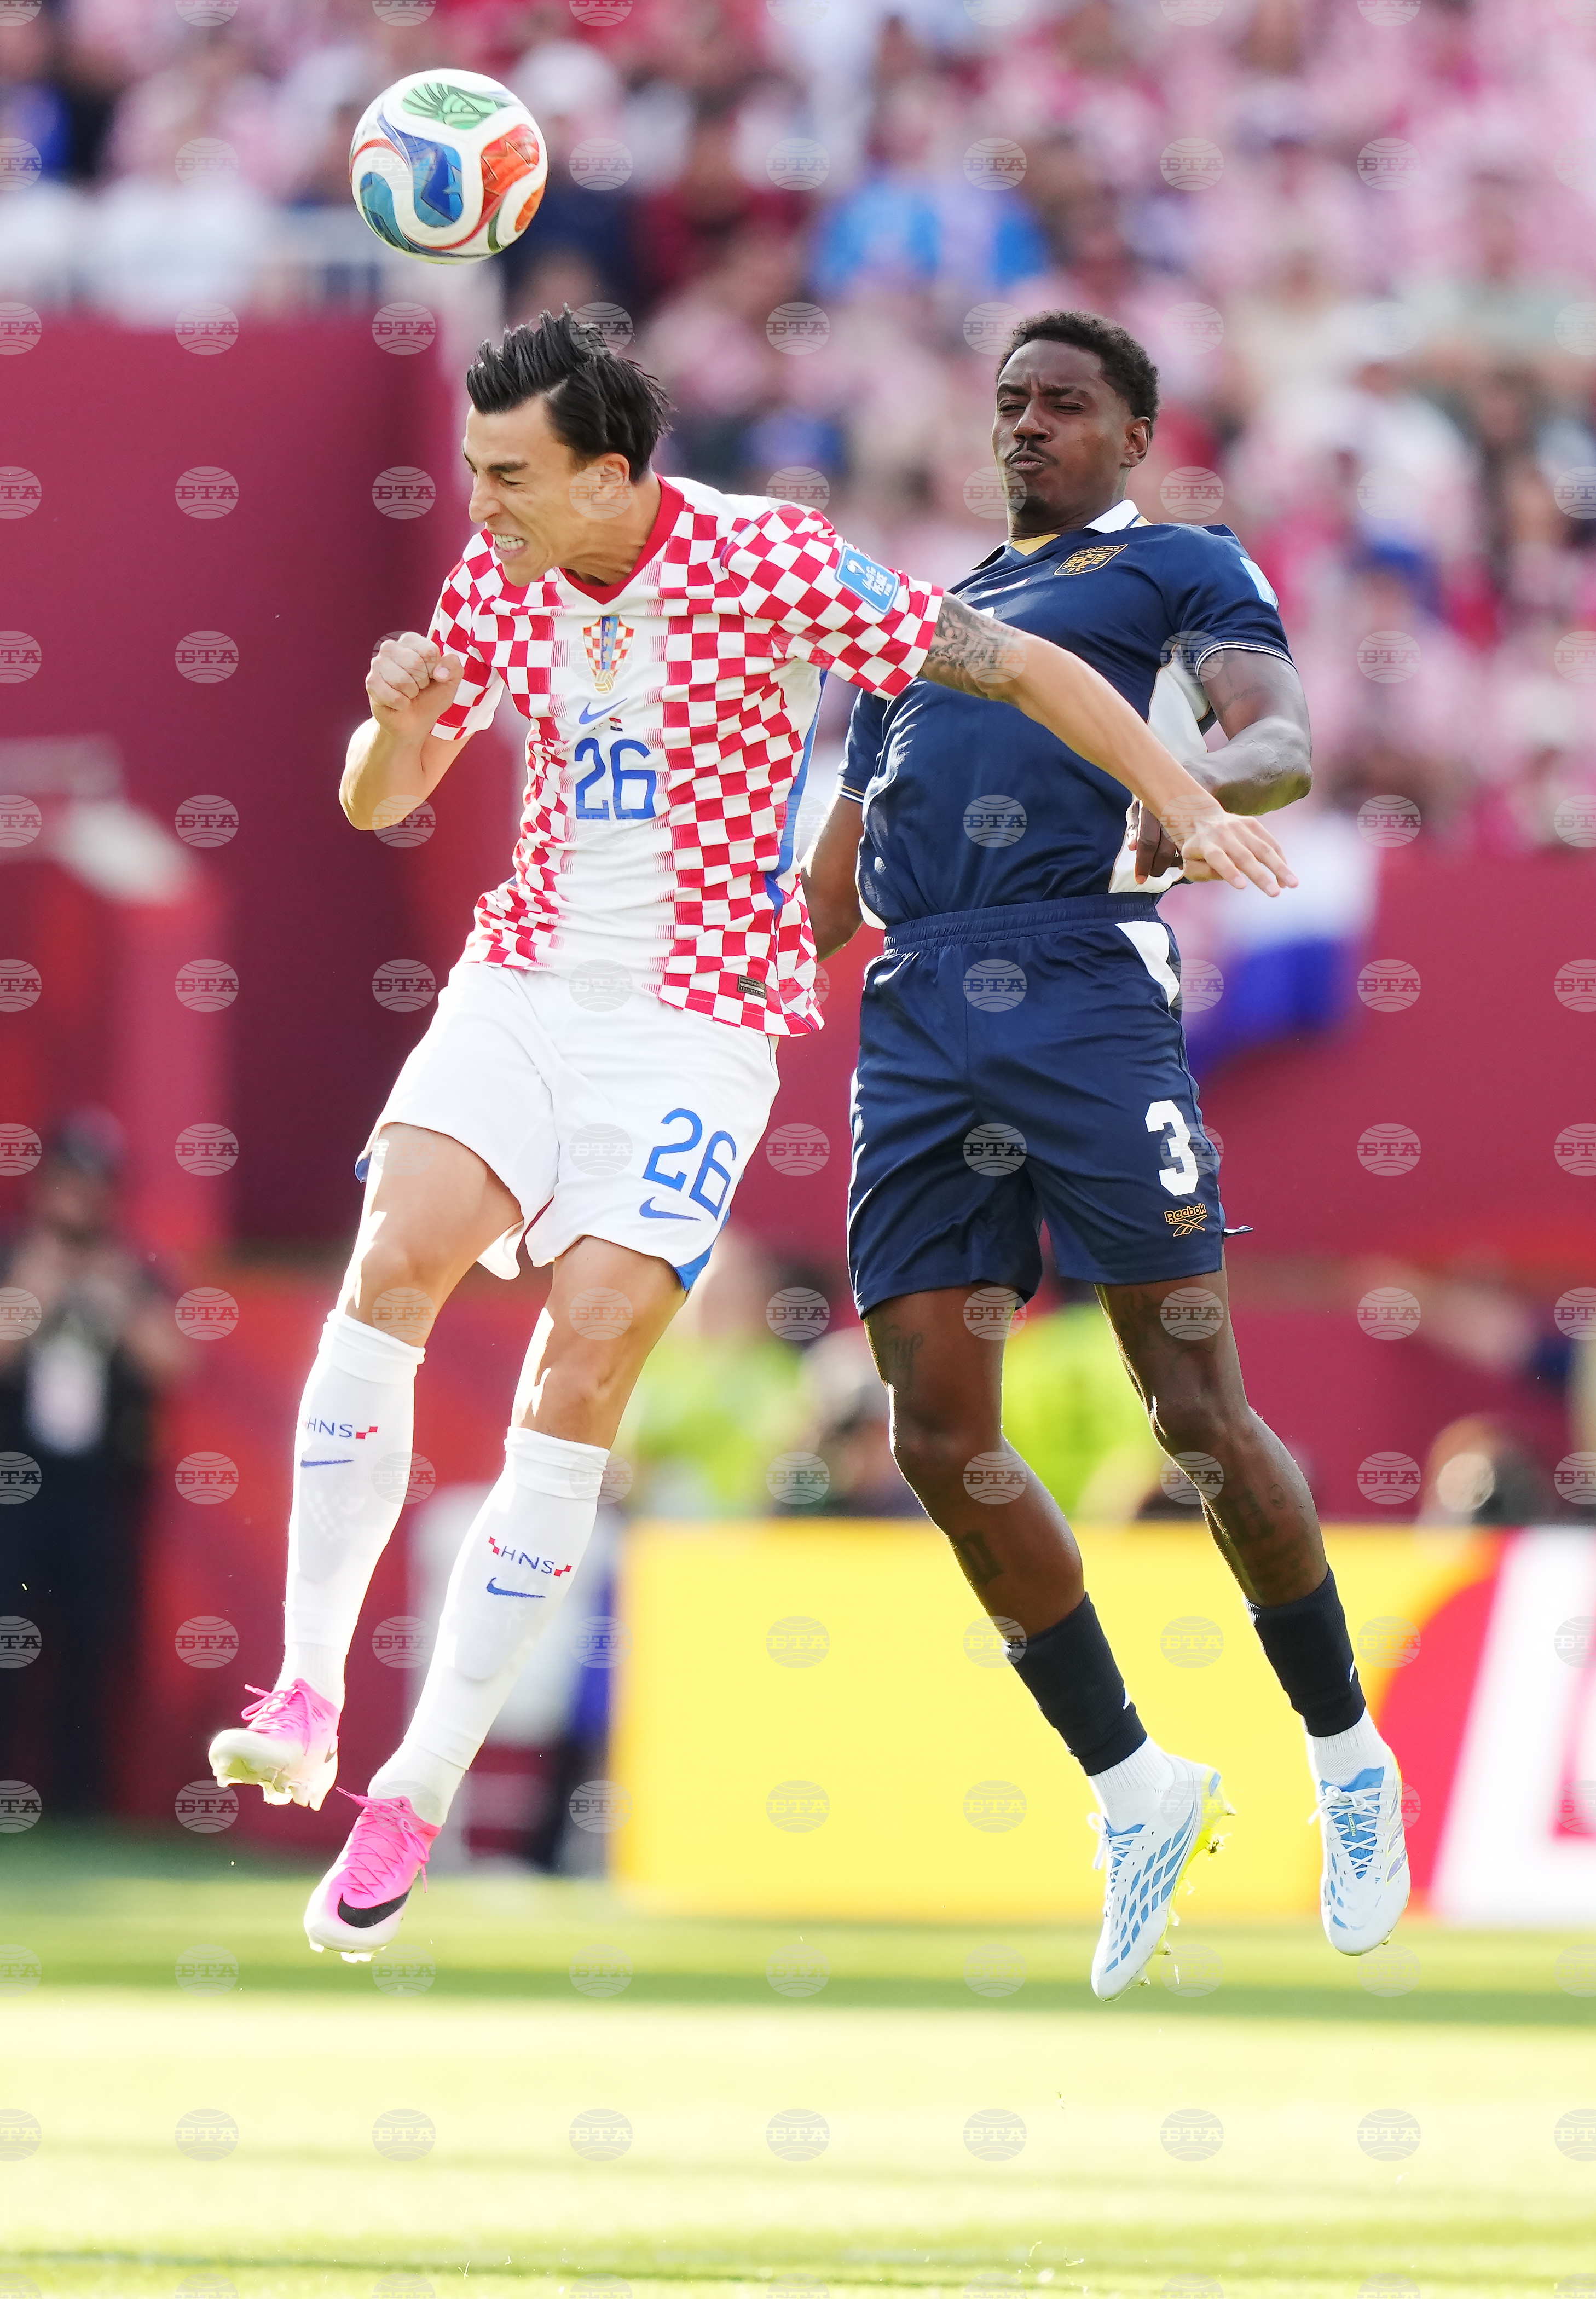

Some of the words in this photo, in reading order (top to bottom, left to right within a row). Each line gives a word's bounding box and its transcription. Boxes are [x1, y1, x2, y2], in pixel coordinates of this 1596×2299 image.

[575, 737, 657, 821] 26
[642, 1108, 737, 1221] 26
[1144, 1100, 1199, 1196] 3
[1164, 1203, 1207, 1223] Reebok
[307, 1416, 353, 1438] HNS
[501, 1545, 554, 1574] HNS
